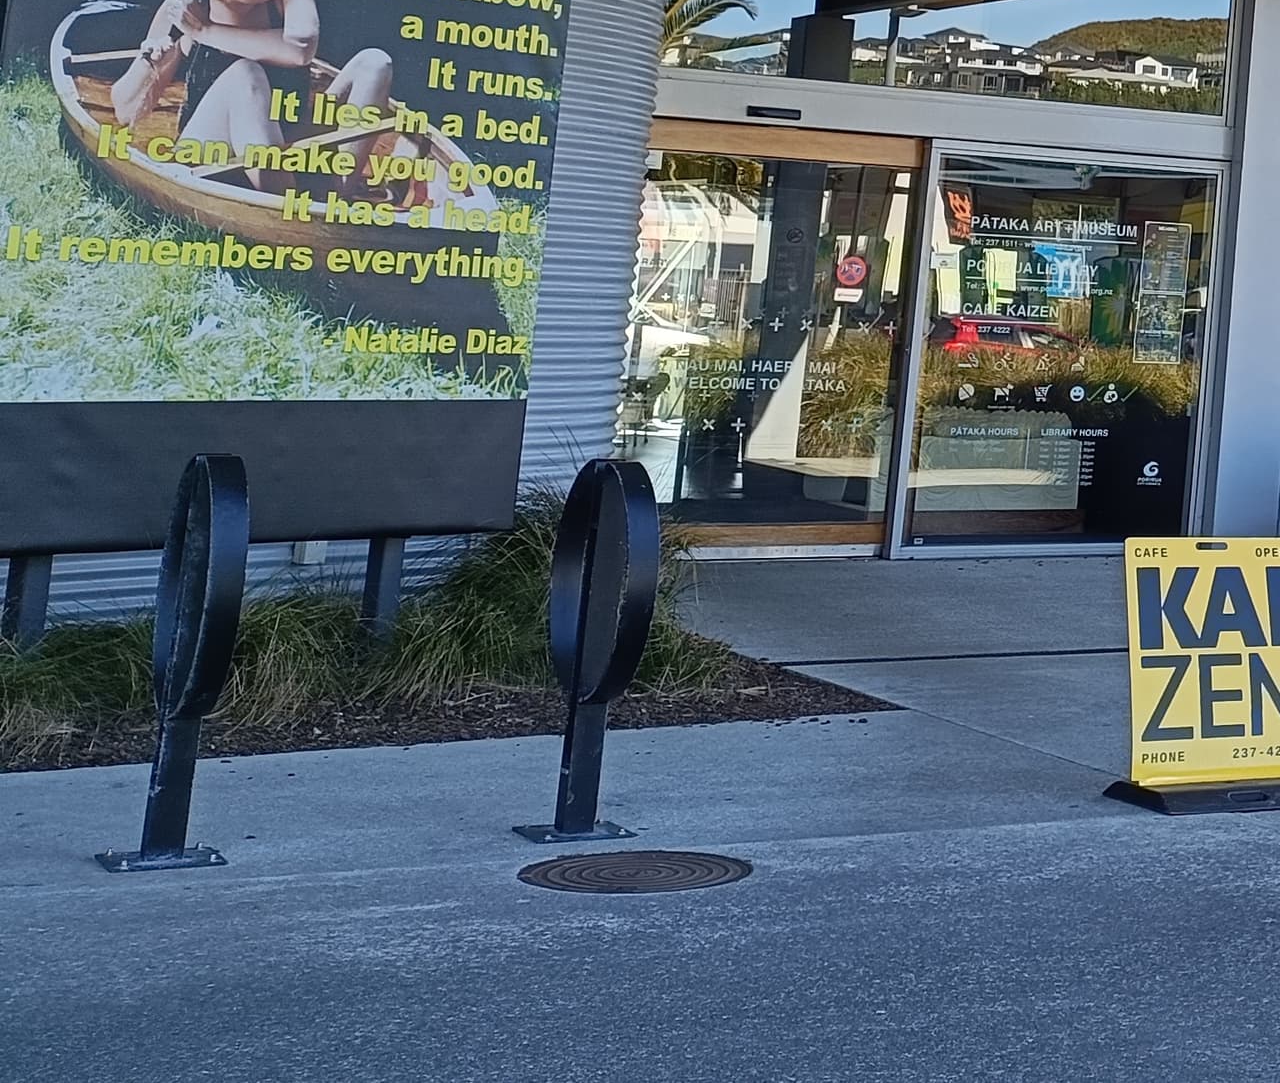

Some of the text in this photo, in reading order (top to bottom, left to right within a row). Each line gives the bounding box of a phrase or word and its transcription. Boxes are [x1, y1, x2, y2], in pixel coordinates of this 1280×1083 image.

[401, 16, 558, 56] a mouth.
[428, 59, 554, 100] It runs.
[270, 89, 548, 145] It lies in a bed.
[97, 127, 544, 191] It can make you good.
[282, 190, 538, 235] It has a head.
[971, 214, 1029, 232] PĀTAKA
[1077, 224, 1137, 238] MUSEUM
[986, 238, 999, 247] 237
[6, 227, 535, 283] It remembers everything.
[967, 260, 1033, 275] POUA
[1007, 304, 1059, 318] KAIZEN
[344, 327, 456, 355] Natalie
[467, 331, 527, 355] Diaz
[676, 359, 709, 371] NAU
[751, 360, 795, 372] HAER
[808, 361, 835, 374] MAI
[674, 377, 755, 390] WELCOME
[760, 378, 782, 390] TO
[988, 428, 1018, 436] HOURS
[1079, 429, 1109, 437] HOURS
[1134, 547, 1168, 558] CAFE
[1142, 751, 1185, 764] PHONE
